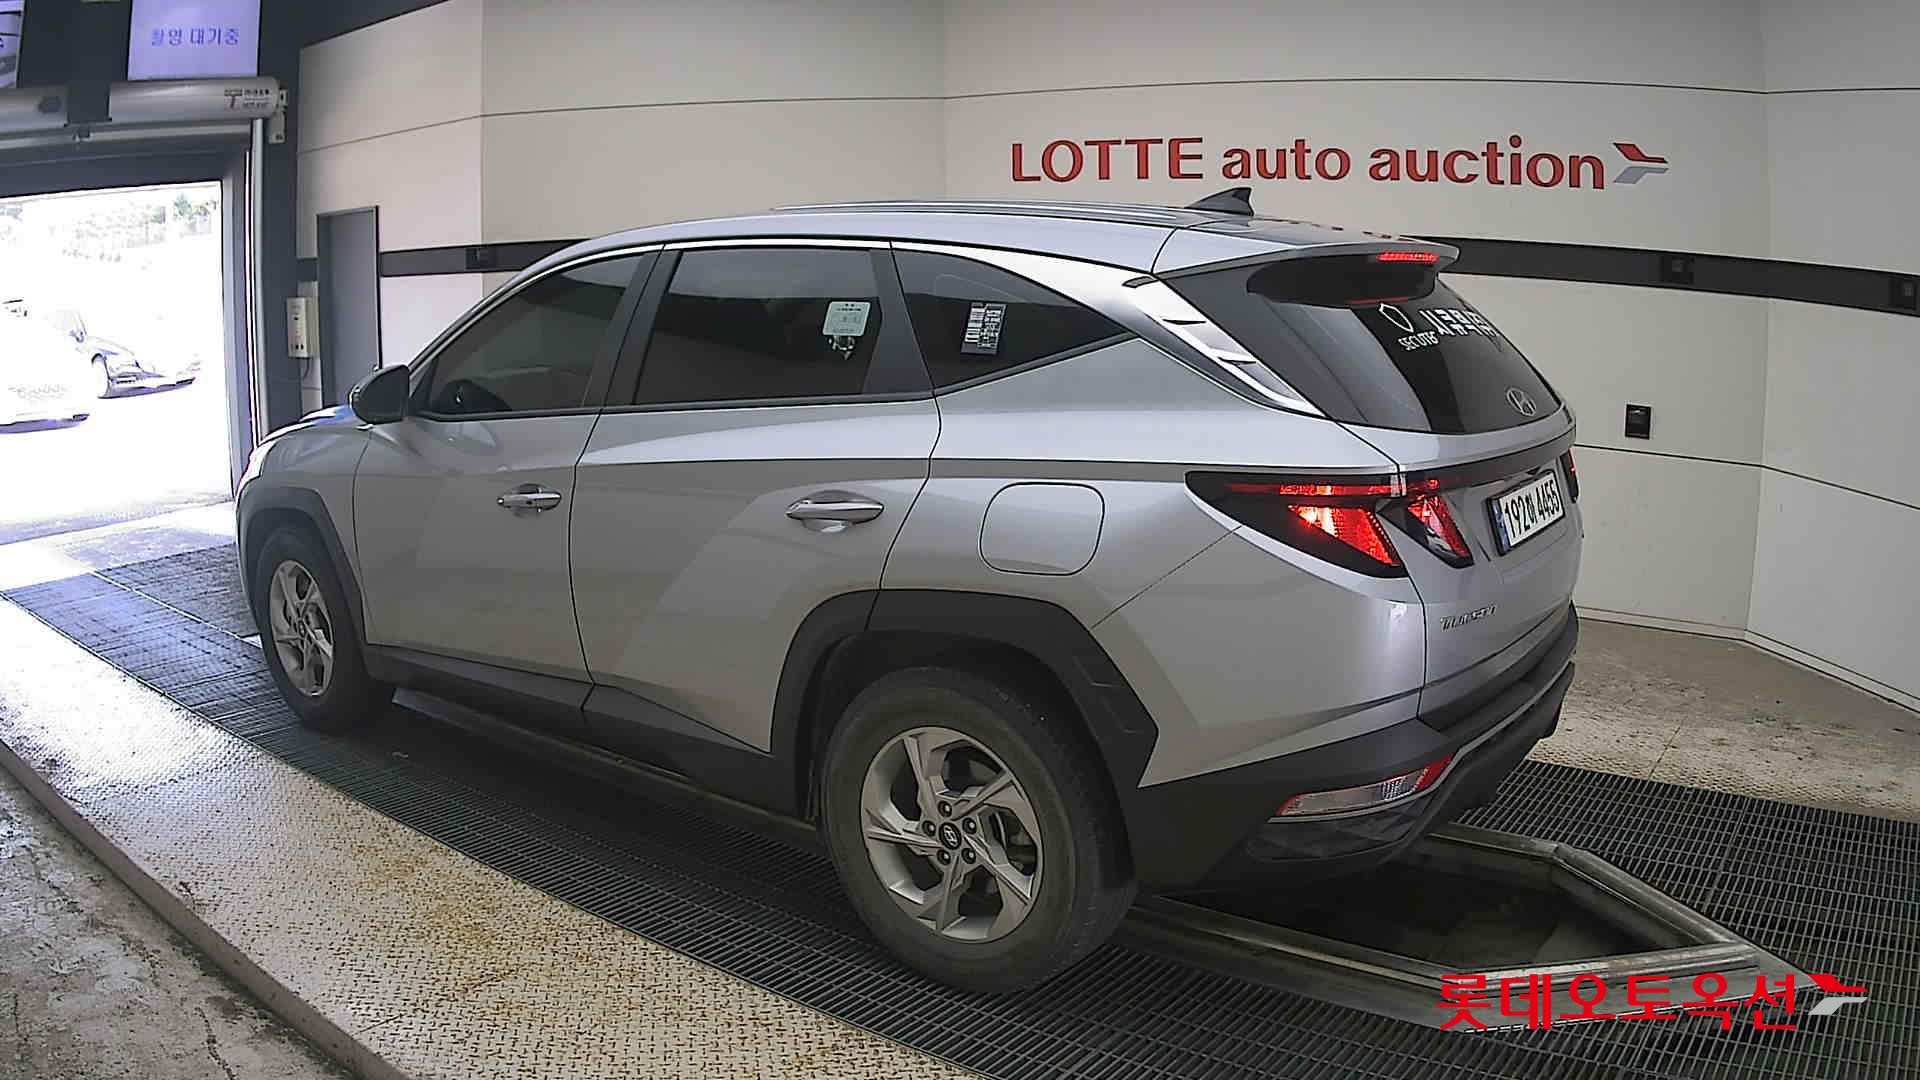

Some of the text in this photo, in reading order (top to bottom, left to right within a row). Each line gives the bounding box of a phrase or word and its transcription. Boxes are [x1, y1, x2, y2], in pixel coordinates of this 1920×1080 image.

[190, 28, 240, 46] 대기중
[1011, 134, 1604, 190] LOTTE auto auction
[1535, 479, 1560, 521] 4455
